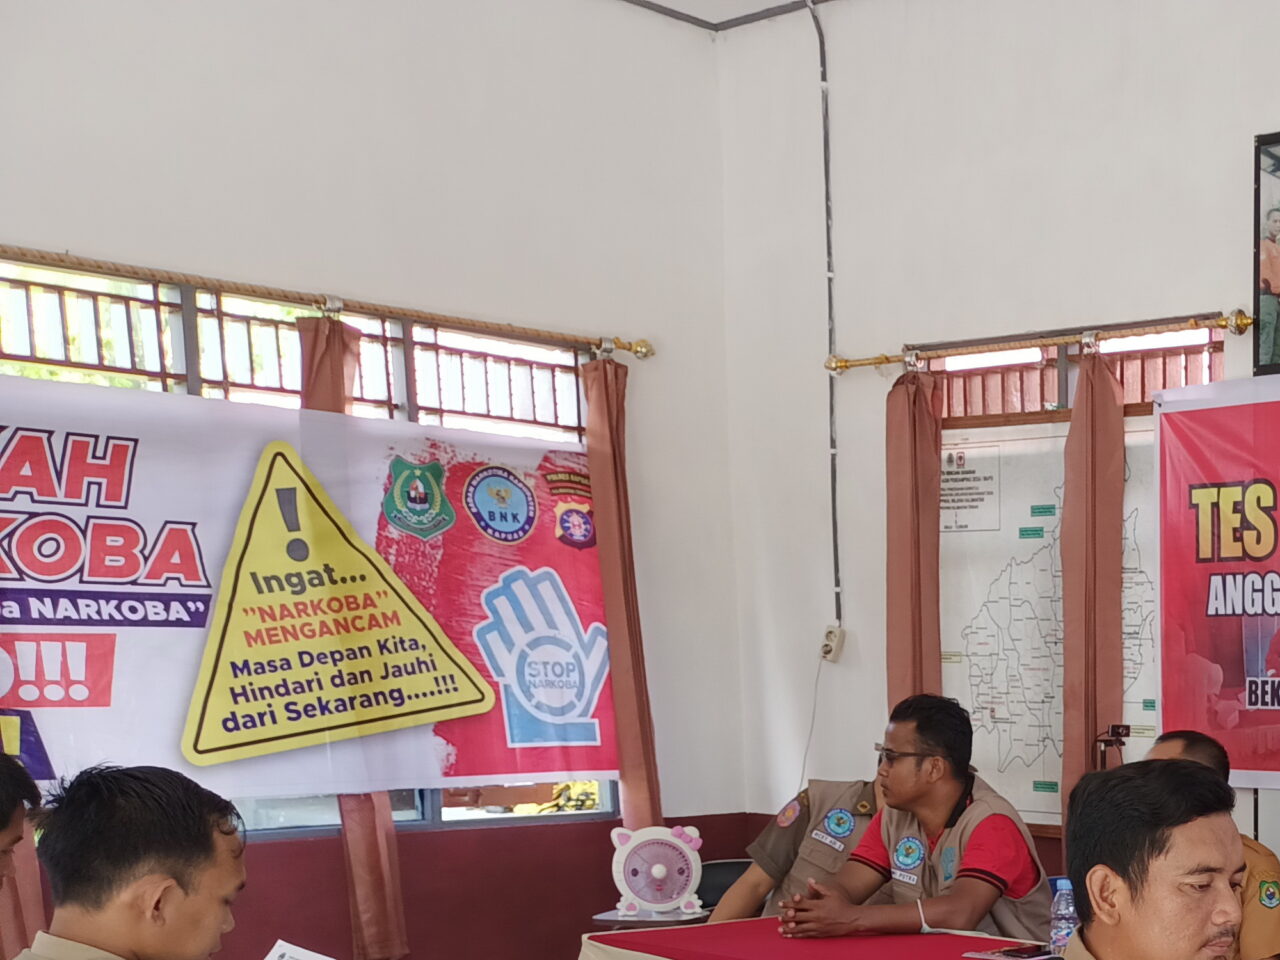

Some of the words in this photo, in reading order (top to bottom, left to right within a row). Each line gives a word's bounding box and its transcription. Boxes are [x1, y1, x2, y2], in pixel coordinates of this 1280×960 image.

[0, 426, 139, 510] AH
[488, 511, 520, 523] BNK
[1190, 479, 1277, 562] TES
[249, 563, 367, 596] Ingat...
[0, 600, 21, 619] a
[243, 610, 402, 648] MENGANCAM
[229, 657, 292, 679] Masa
[297, 644, 372, 669] Depan
[376, 634, 427, 656] Kita,
[527, 661, 576, 678] STOP
[228, 671, 324, 706] Hindari
[330, 669, 374, 691] dan
[379, 653, 438, 681] Jauhi
[528, 680, 578, 690] NARKOBA
[221, 703, 278, 734] dari
